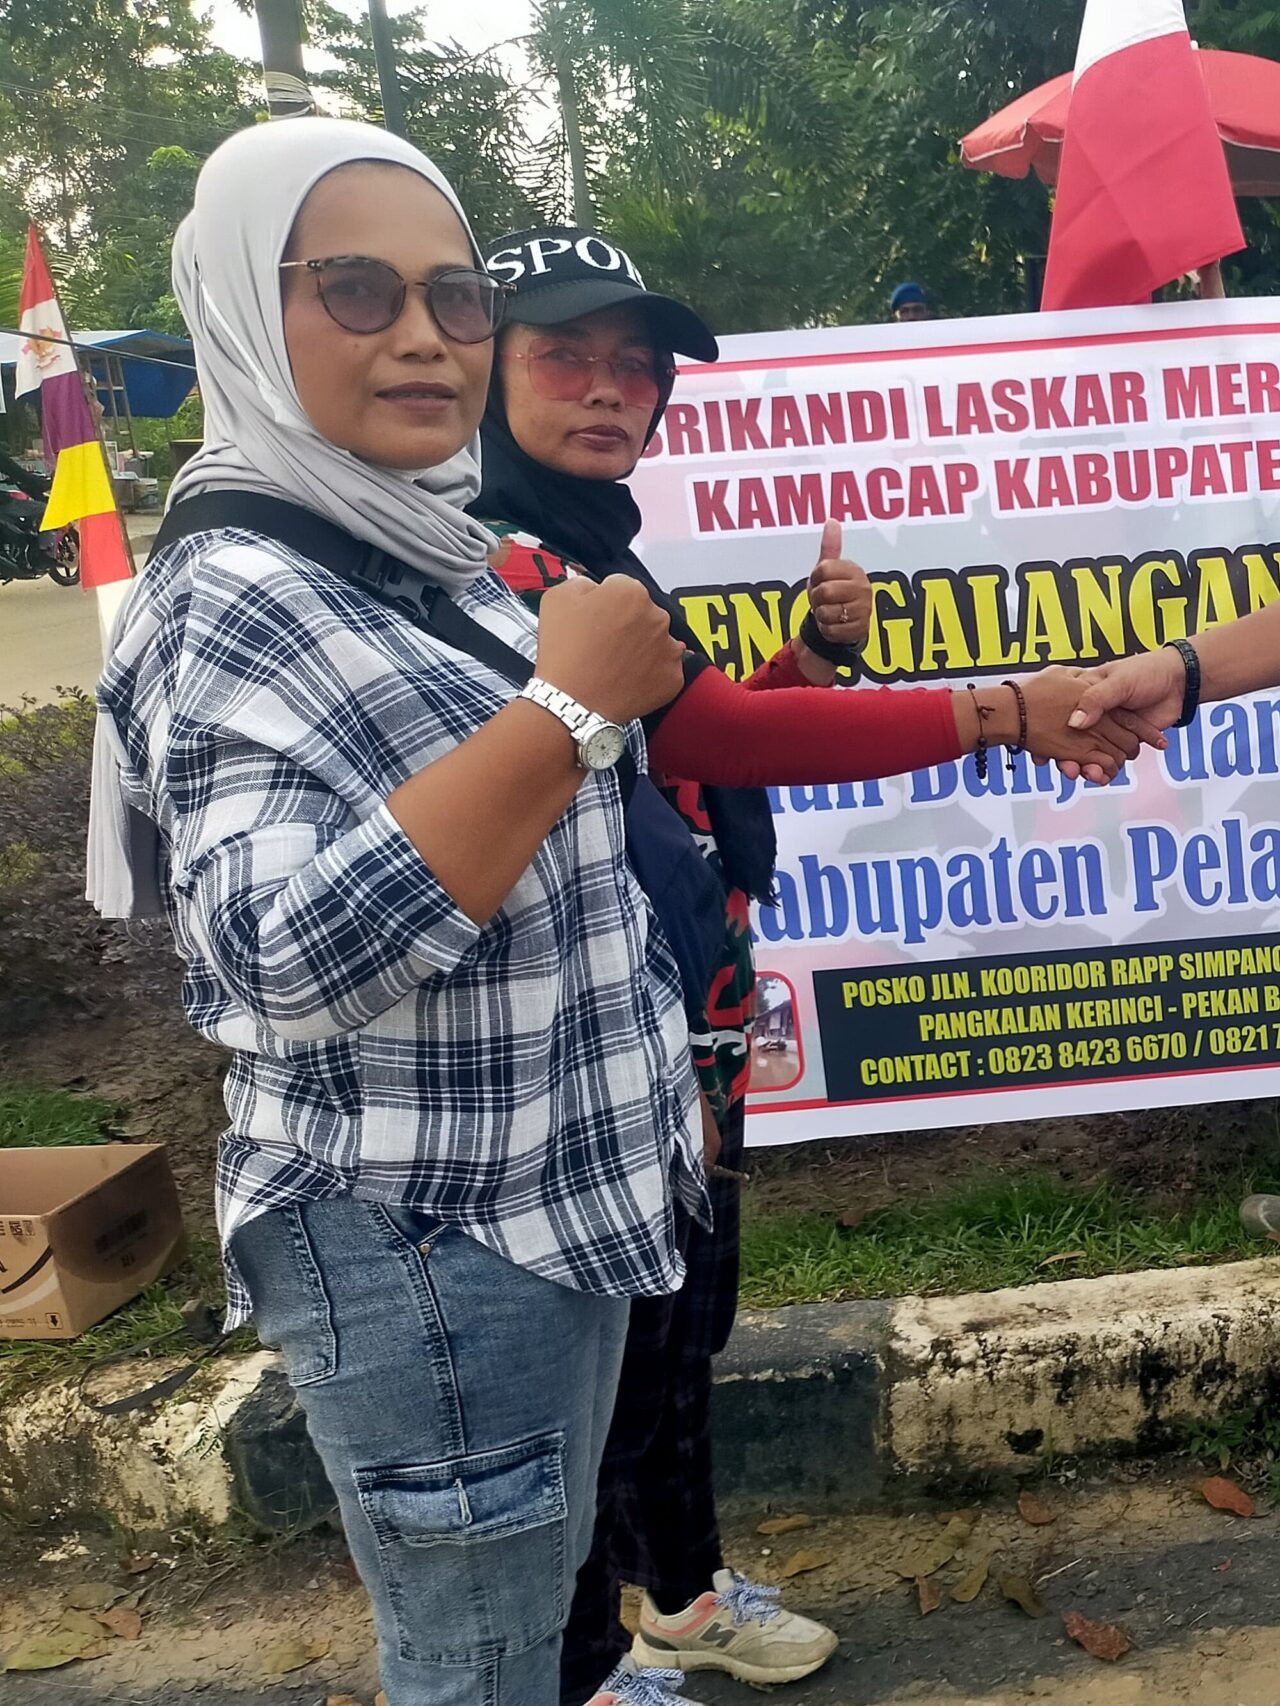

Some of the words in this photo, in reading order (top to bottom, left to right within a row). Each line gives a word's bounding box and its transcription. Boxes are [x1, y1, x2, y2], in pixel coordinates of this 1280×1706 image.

[923, 370, 1148, 438] LASKAR
[693, 463, 979, 532] KAMACAP
[750, 837, 1108, 945] abupaten
[842, 975, 926, 1009] POSKO
[931, 971, 977, 1001] JLN.
[980, 960, 1106, 997] KOORIDOR
[1111, 955, 1174, 986] RAPP
[919, 1003, 1062, 1042] PANGKALAN
[1066, 994, 1163, 1029] KERINCI
[1182, 987, 1260, 1019] PEKAN
[860, 1051, 971, 1086] CONTACT
[988, 1043, 1053, 1075] 0823
[1058, 1038, 1121, 1069] 8423
[1126, 1031, 1187, 1063] 6670
[1193, 1030, 1204, 1057] /
[1209, 1024, 1269, 1055] 0821
